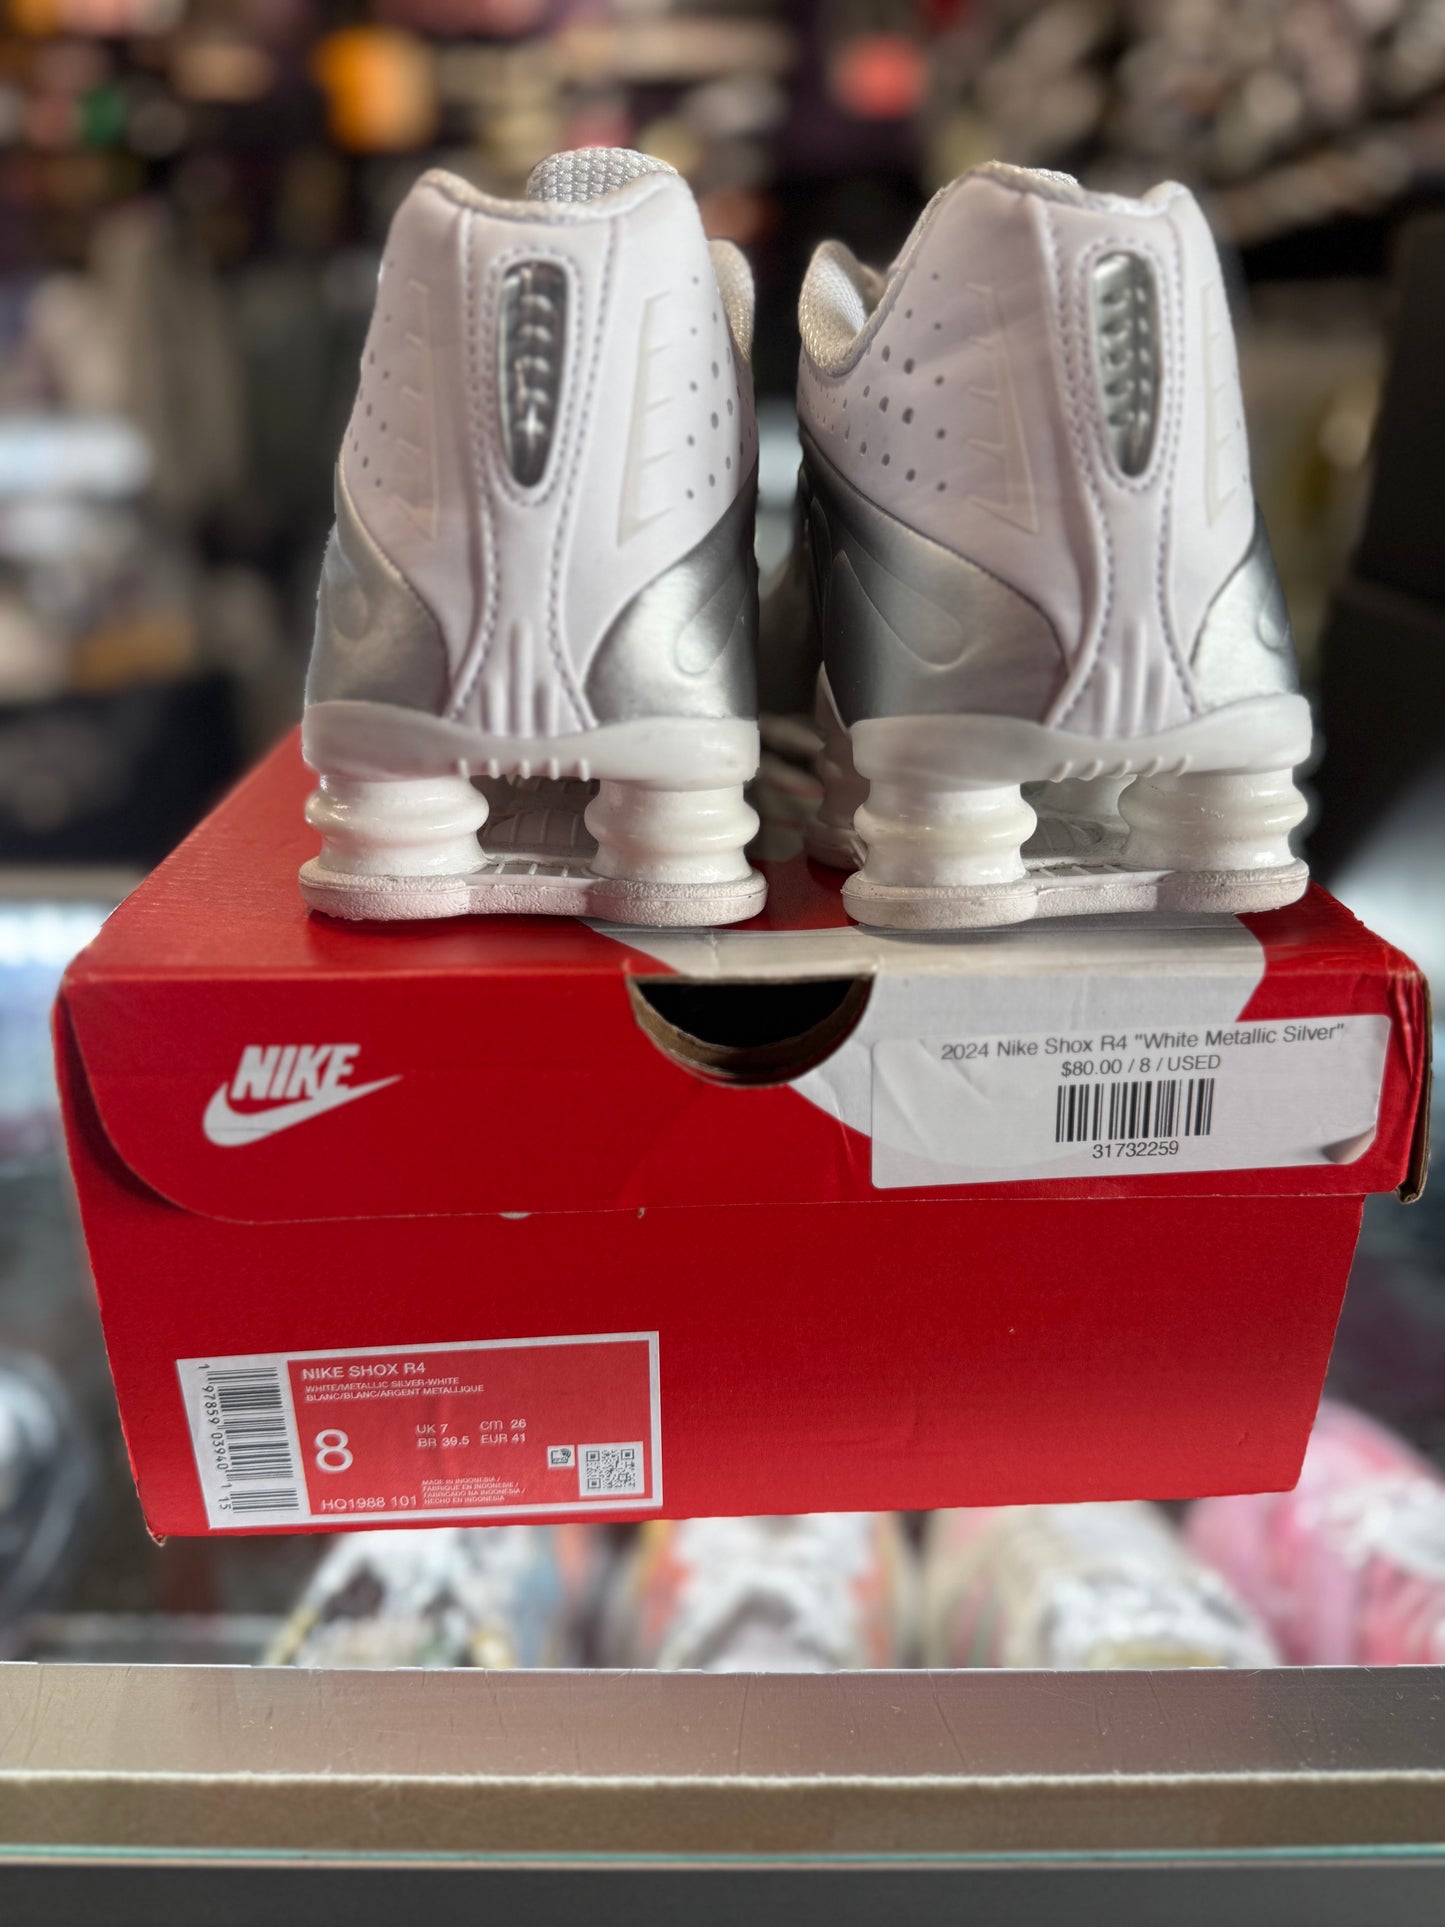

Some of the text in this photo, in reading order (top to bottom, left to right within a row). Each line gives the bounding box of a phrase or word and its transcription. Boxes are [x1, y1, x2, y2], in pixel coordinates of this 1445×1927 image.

[941, 1024, 1345, 1060] 2024 Nike Shox R4 "White Metallic Silver"
[230, 1043, 361, 1101] NIKE
[1061, 1054, 1221, 1078] $80.00 / 8 / USED
[1092, 1140, 1179, 1159] 31732259
[302, 1362, 426, 1380] NIKE SHOX R4
[305, 1377, 460, 1393] WHITE/METALLIC SILVER-WHITE
[306, 1385, 485, 1402] BLANC/BLANC/ARGENT METALLIQUE
[202, 1385, 220, 1424] 97859
[211, 1432, 229, 1470] 03940
[416, 1423, 448, 1434] UK 7
[510, 1418, 527, 1429] 26
[418, 1435, 470, 1447] BR 39.5
[481, 1433, 526, 1444] EUR 41
[314, 1428, 353, 1473] 8
[321, 1495, 417, 1510] HQ1988 101
